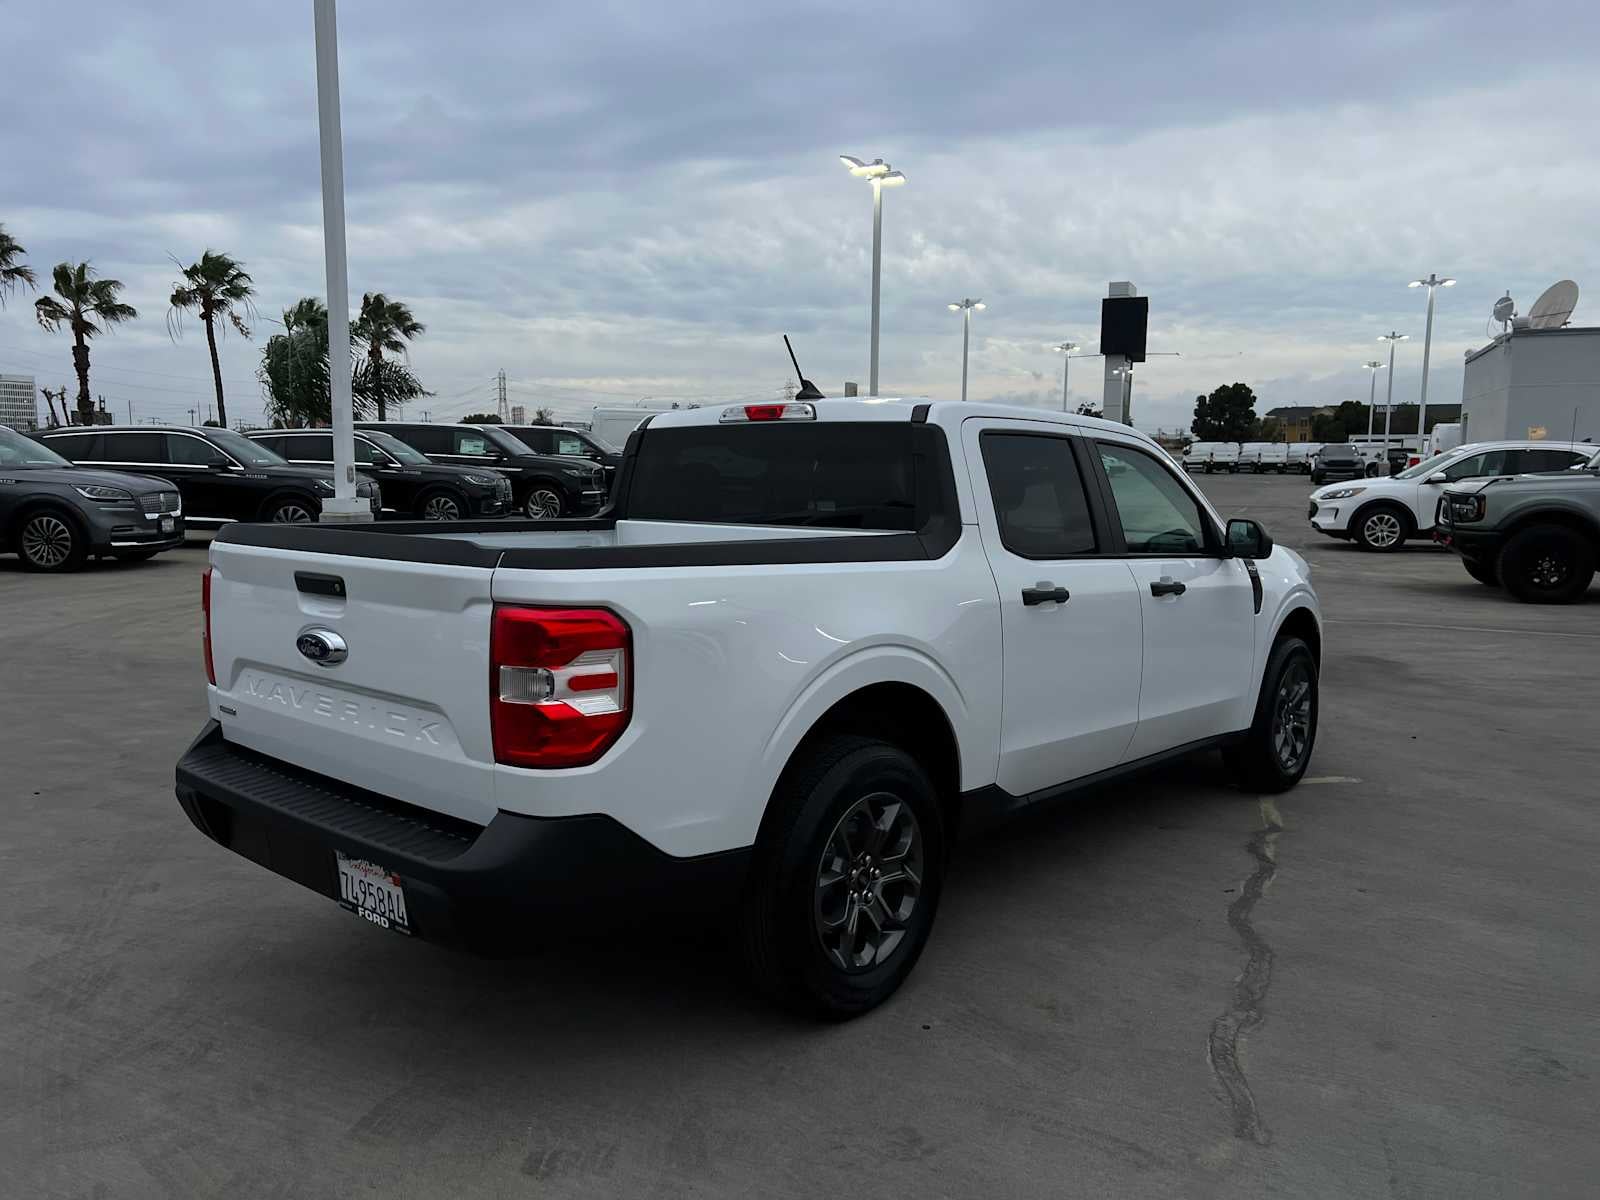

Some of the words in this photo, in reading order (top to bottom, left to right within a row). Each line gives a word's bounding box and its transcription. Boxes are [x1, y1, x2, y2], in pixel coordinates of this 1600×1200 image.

[245, 674, 441, 745] MAVERICK
[341, 871, 405, 924] 74958A4
[358, 906, 390, 929] FORD
